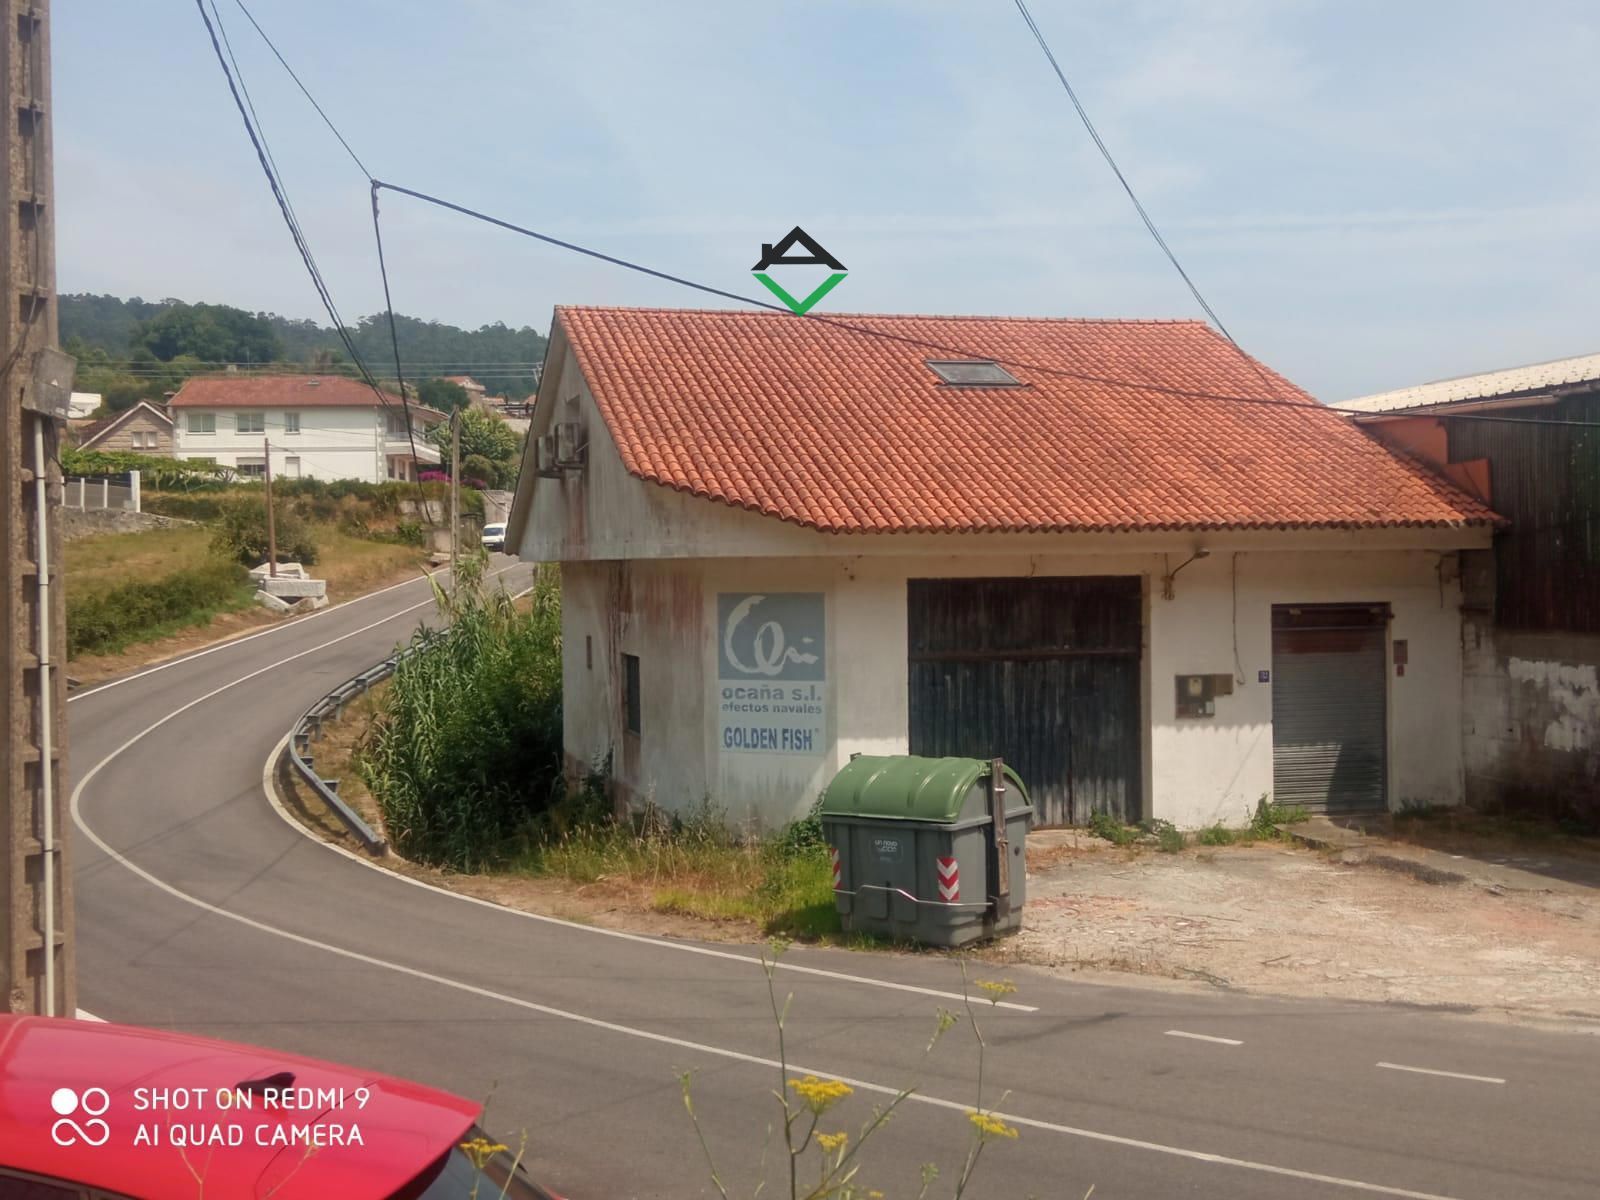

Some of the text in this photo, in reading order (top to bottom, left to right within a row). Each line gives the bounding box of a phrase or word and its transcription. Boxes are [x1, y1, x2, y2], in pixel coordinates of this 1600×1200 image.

[721, 684, 822, 701] ocaña s.l.
[721, 701, 822, 714] efectos navales
[723, 726, 813, 751] GOLDEN FISH
